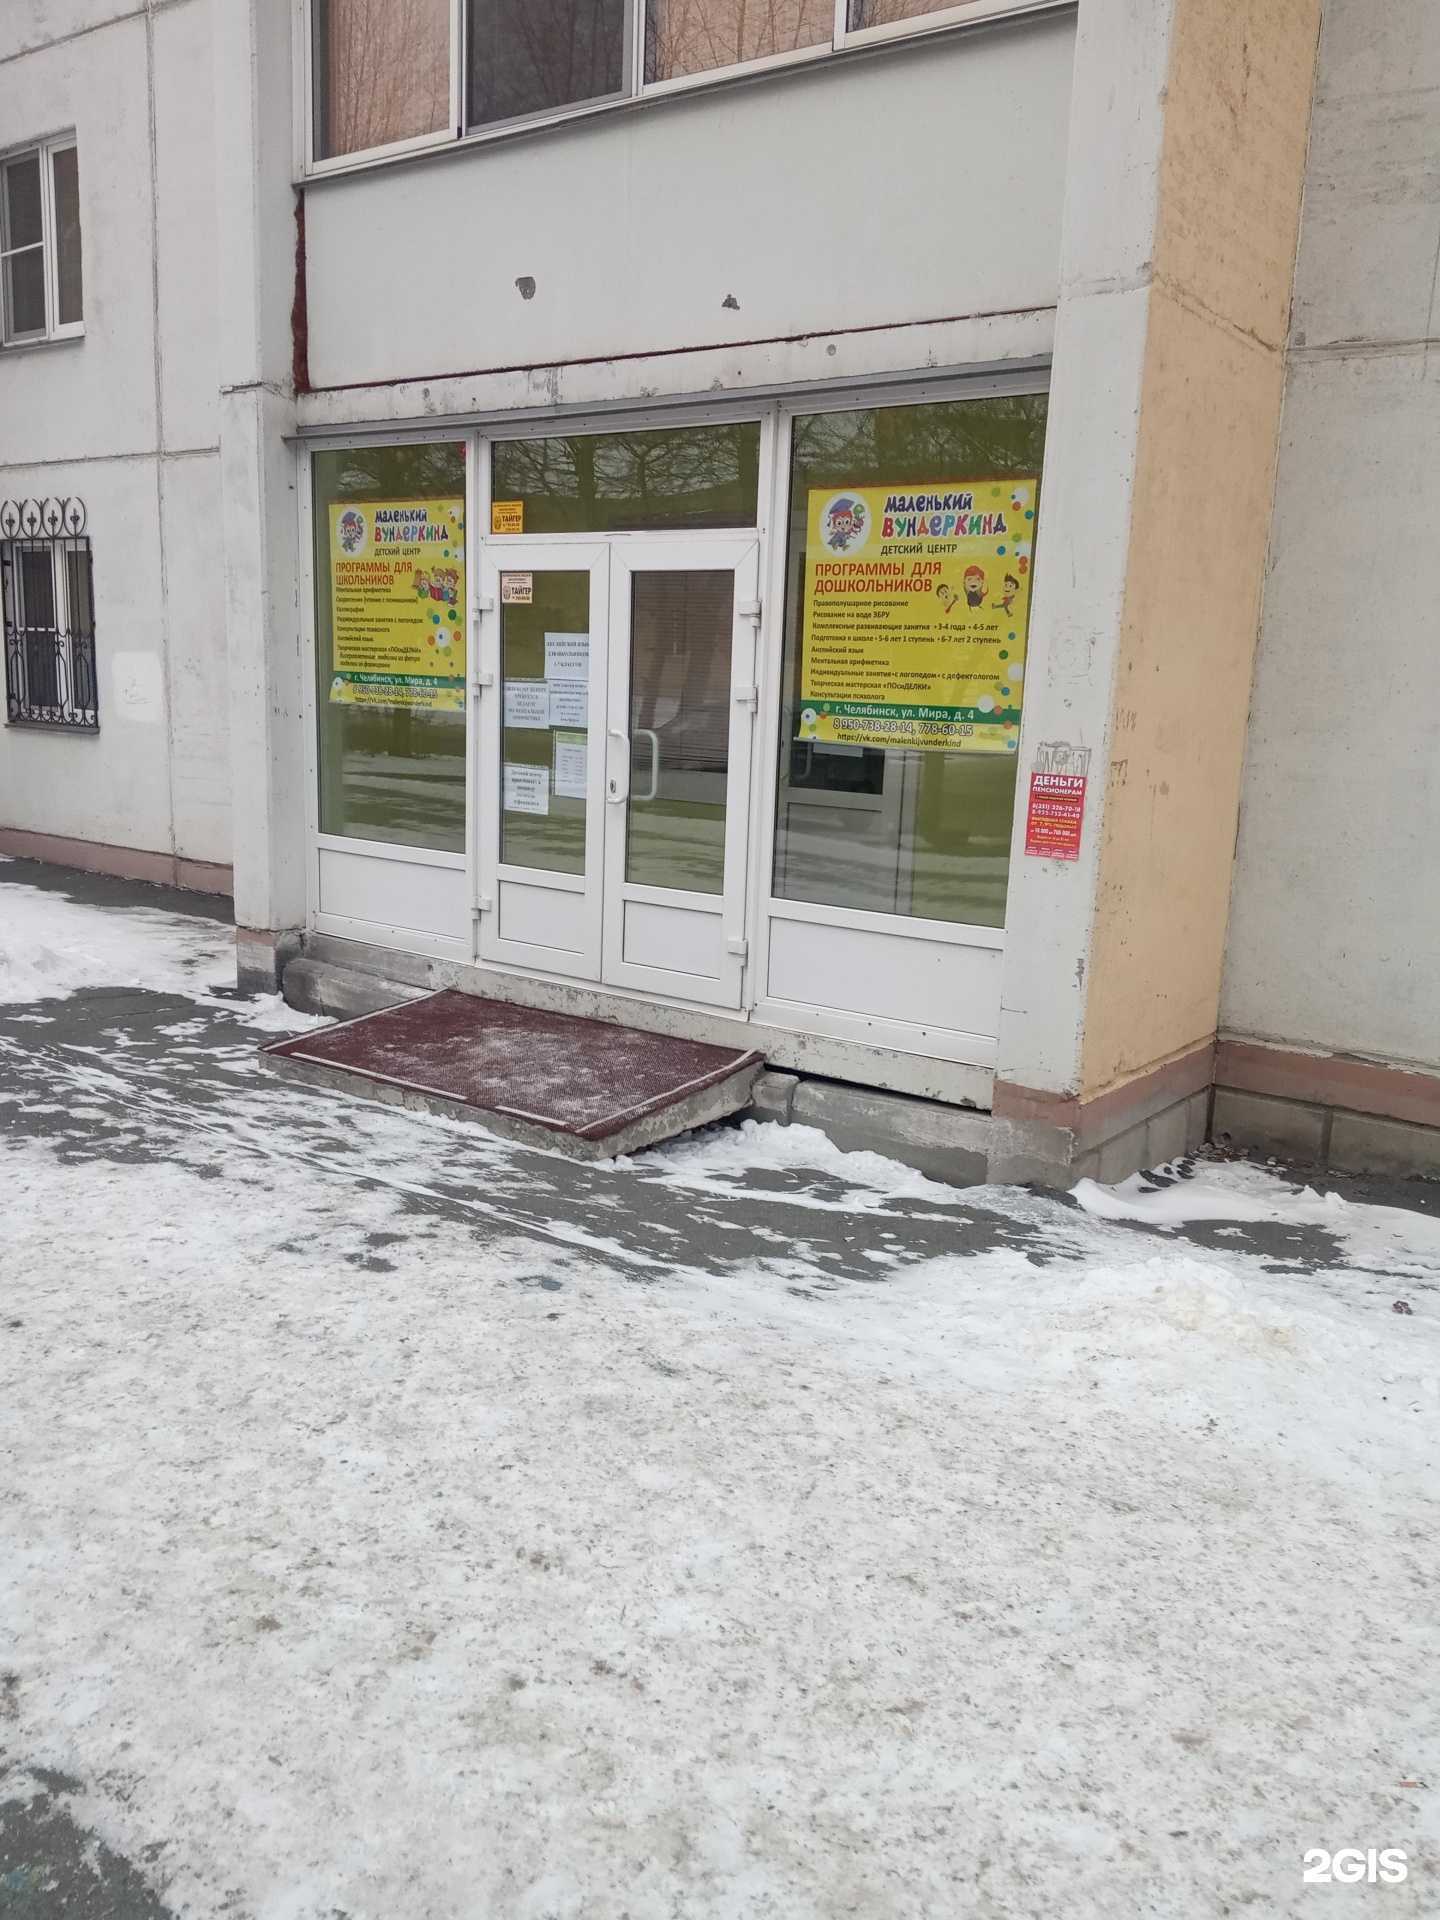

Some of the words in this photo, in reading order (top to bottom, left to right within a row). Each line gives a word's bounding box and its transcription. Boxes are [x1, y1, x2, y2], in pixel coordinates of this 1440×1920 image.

[375, 547, 400, 556] ДЕТСКИЙ
[402, 548, 421, 556] ЦЕНТР
[881, 543, 923, 556] ДЕТСКИЙ
[928, 544, 957, 555] ЦЕНТР
[336, 562, 389, 573] ПРОГРАММЫ
[394, 562, 413, 574] ДЛЯ
[815, 562, 904, 576] ПРОГРАММЫ
[912, 562, 941, 576] ДЛЯ
[336, 574, 394, 585] ШКОЛЬНИКОВ
[511, 586, 532, 595] ТАЙГЕР
[814, 578, 932, 595] ДОШКОЛЬНИКОВ
[813, 600, 871, 608] Правополушарное
[813, 611, 845, 619] Рисование
[812, 622, 854, 630] Комплексные
[856, 623, 902, 631] развивающие
[938, 623, 949, 631] 3-4
[950, 624, 966, 632] года
[973, 623, 984, 631] 4-5
[811, 634, 847, 642] Подготовка
[908, 636, 935, 644] ступень
[941, 635, 952, 643] 6-7
[972, 637, 1002, 645] ступень
[811, 646, 847, 654] Английский
[810, 657, 848, 665] Ментальная
[810, 668, 864, 678] Индивидуальные
[899, 672, 937, 680] логопедом
[946, 673, 1000, 681] дефектологом
[810, 680, 844, 689] Творческая
[845, 681, 882, 689] мастерская
[810, 691, 851, 700] Консультации
[835, 706, 842, 714] г.
[844, 705, 899, 718] Челябинск,
[901, 709, 915, 719] ул.
[918, 708, 951, 720] Мира,
[954, 710, 966, 721] д.
[967, 709, 974, 719] 4
[919, 723, 974, 737] 778-60-15
[1033, 775, 1084, 788] ДЕНЬГИ
[1032, 787, 1082, 796] ПЕНСИОНЕРАМ
